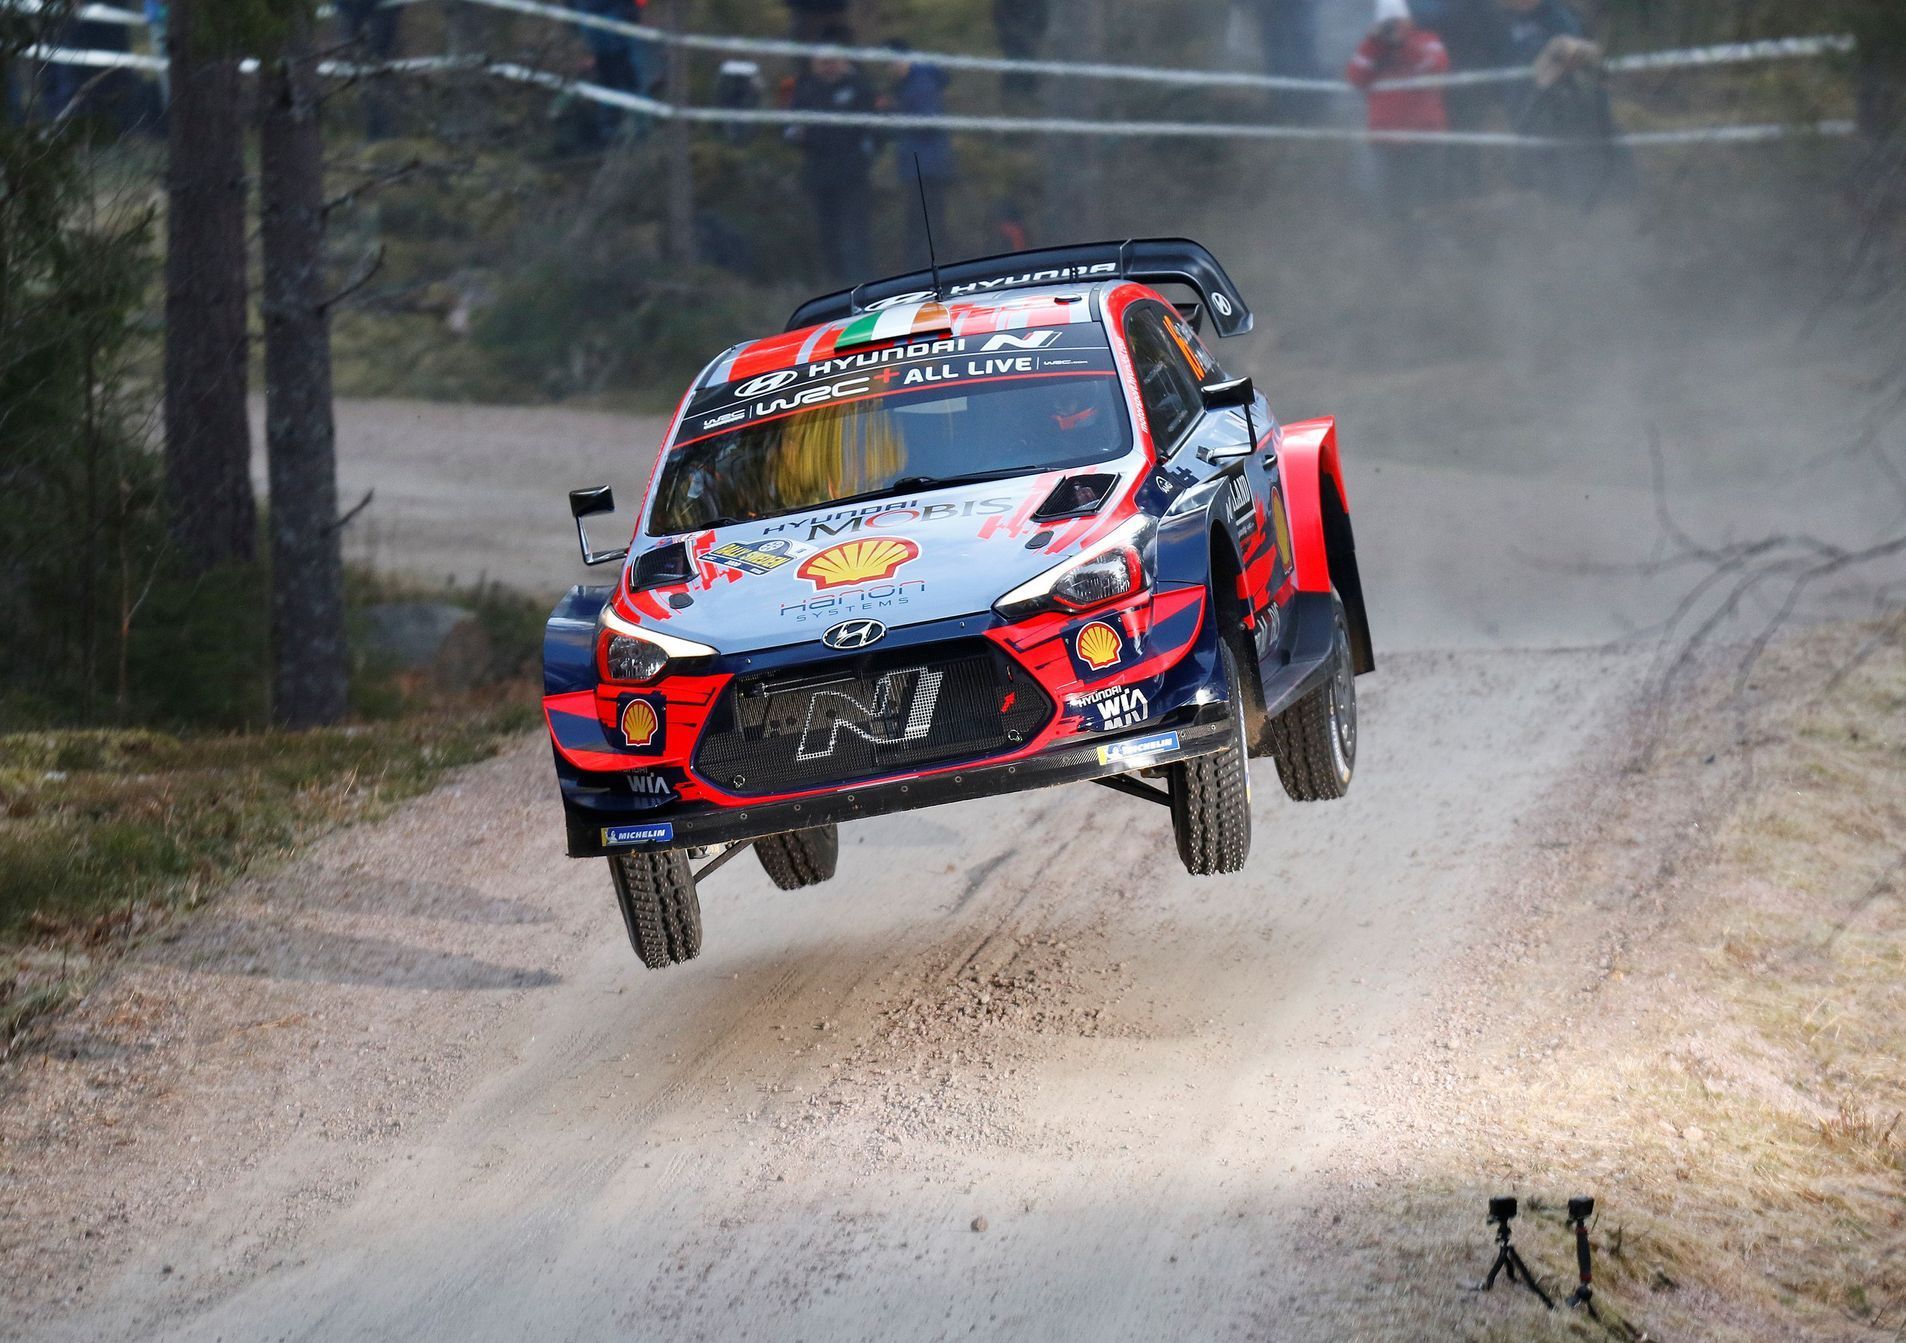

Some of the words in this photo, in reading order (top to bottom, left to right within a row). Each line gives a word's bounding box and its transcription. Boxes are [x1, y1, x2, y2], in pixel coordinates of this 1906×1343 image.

[808, 338, 966, 378] HYUNDAI
[903, 364, 959, 384] ALL
[968, 357, 1032, 376] LIVE
[762, 500, 918, 535] HYUNDAI
[806, 496, 1013, 541] MOBIS
[796, 597, 909, 622] SYSTEMS
[1079, 684, 1122, 708] HYUNDAI
[1096, 688, 1149, 720] WIA
[796, 665, 944, 761] N
[626, 772, 671, 794] WIA
[618, 829, 666, 840] MICHELIN
